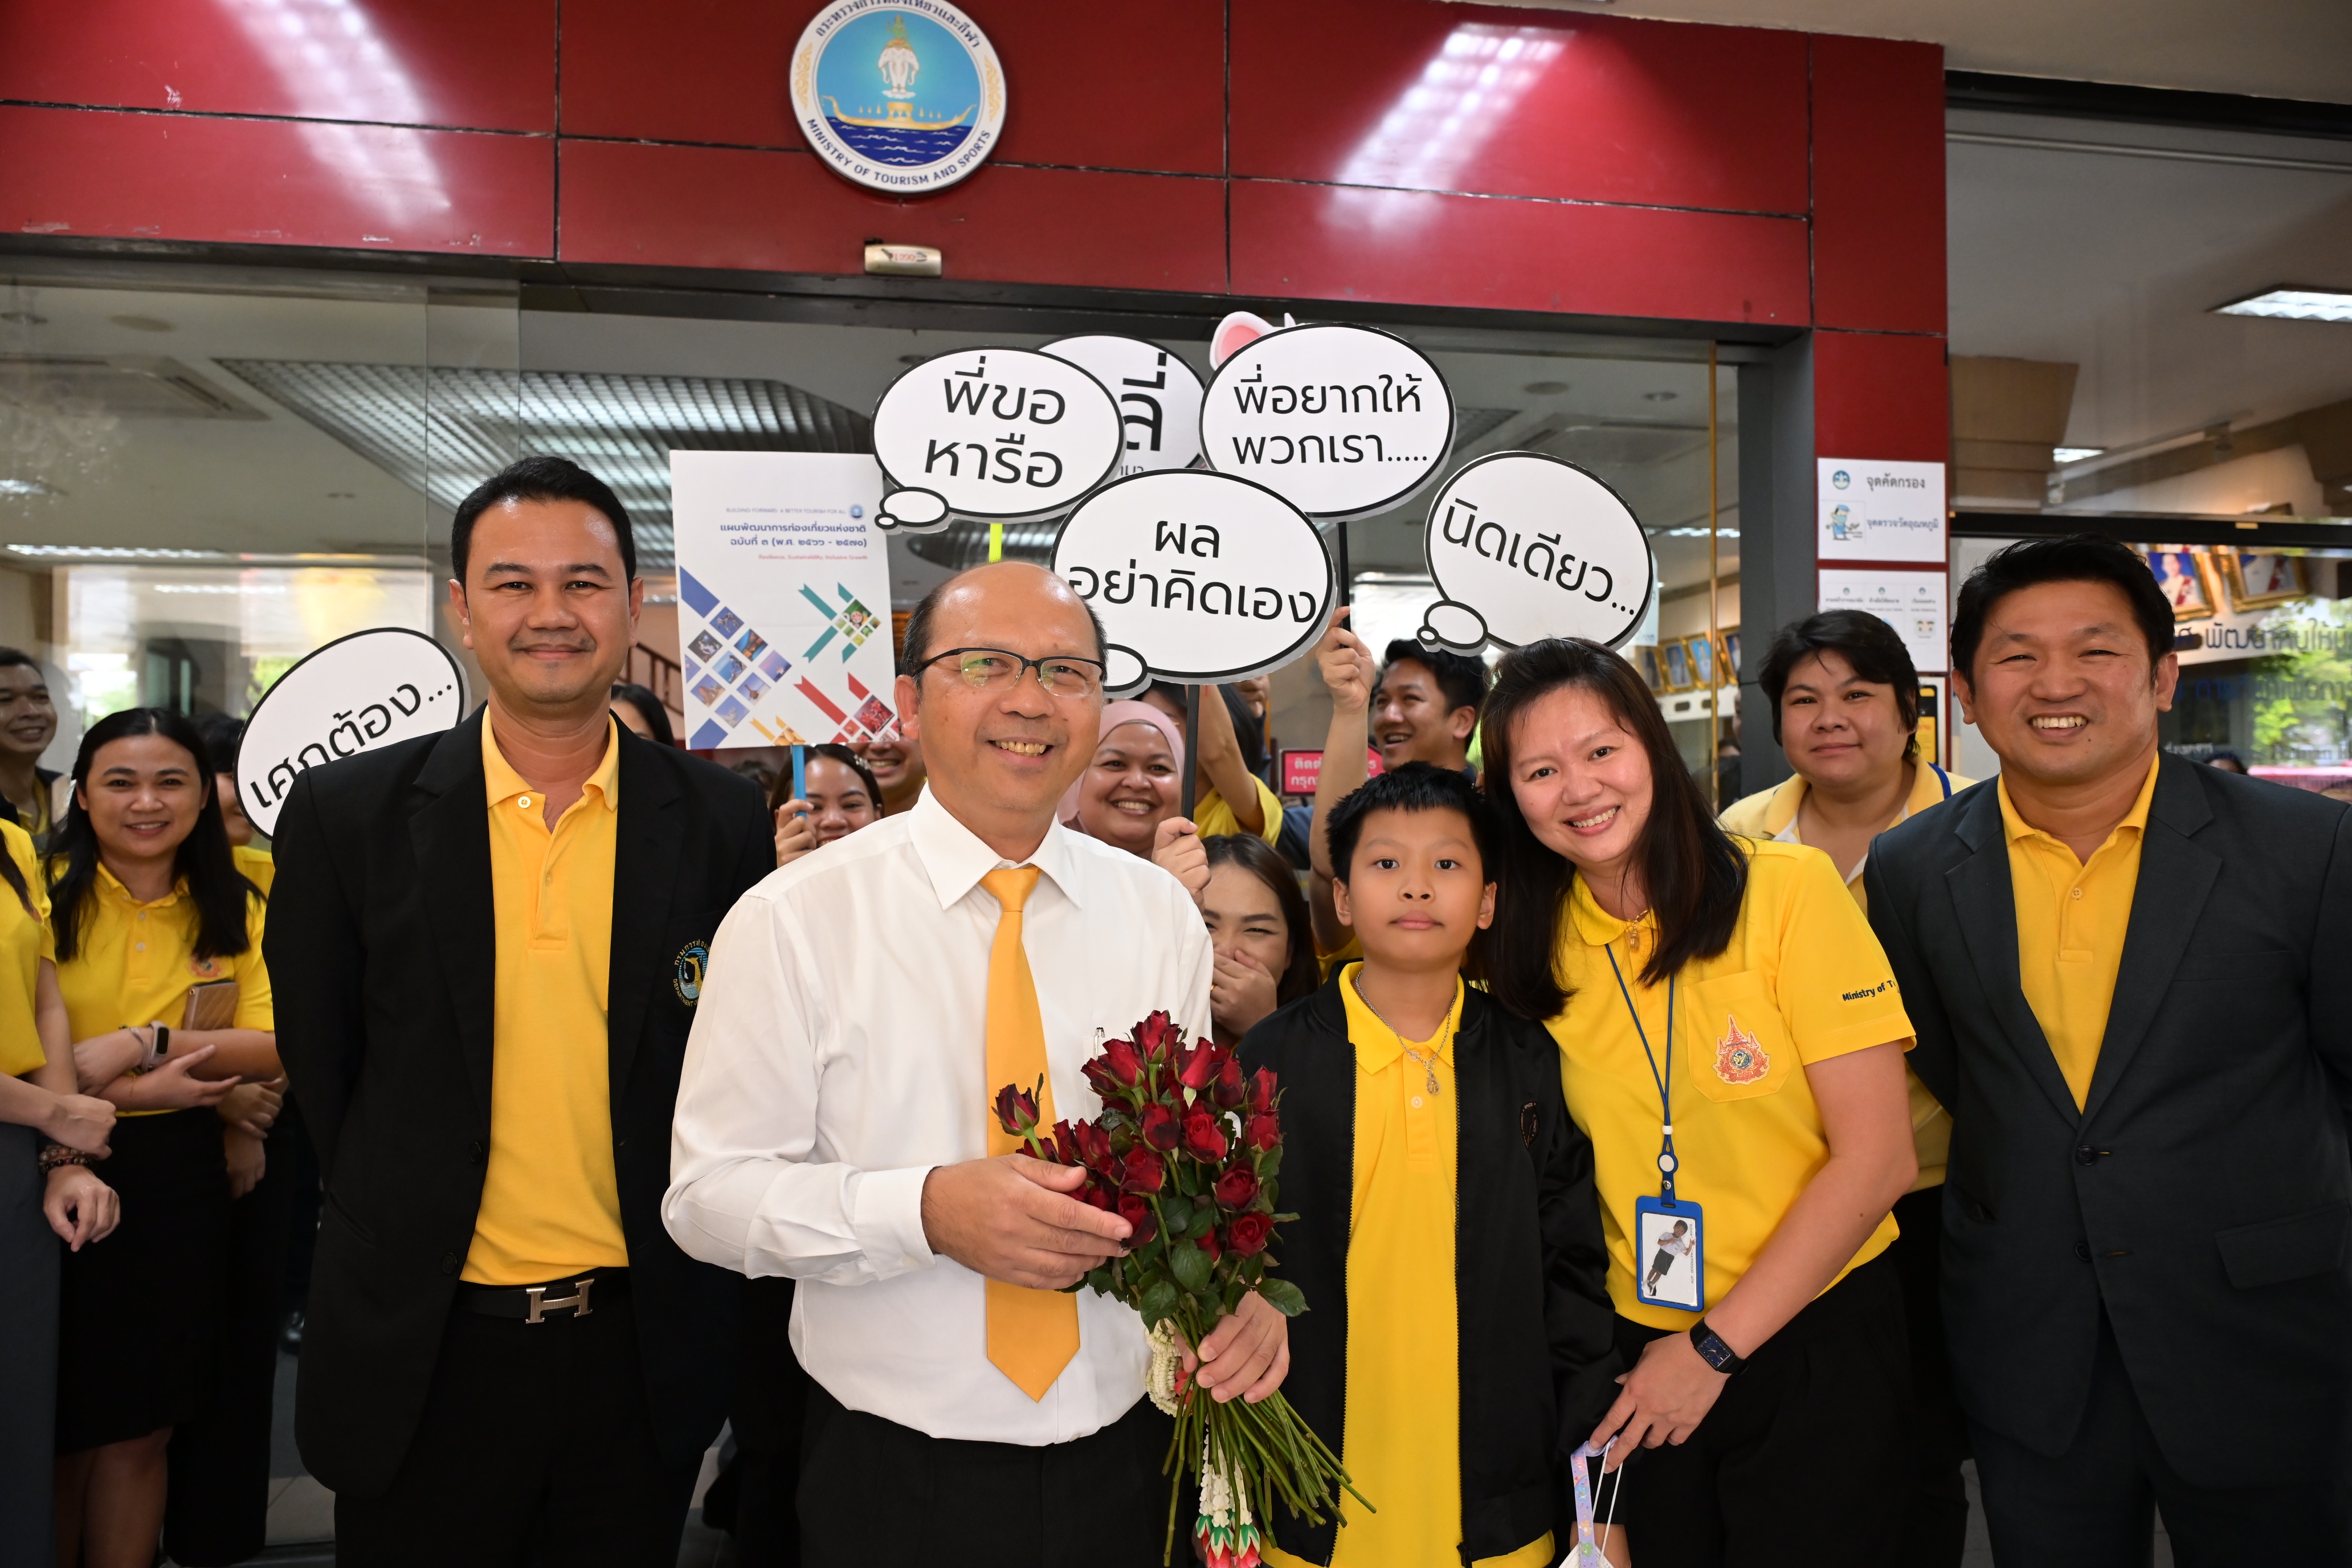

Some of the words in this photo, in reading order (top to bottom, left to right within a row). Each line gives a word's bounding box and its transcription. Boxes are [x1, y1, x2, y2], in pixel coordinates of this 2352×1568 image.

[807, 118, 852, 167] MINISTRY
[854, 164, 869, 177] OF
[874, 172, 929, 185] TOURISM
[933, 165, 958, 181] AND
[958, 130, 991, 168] SPORTS
[943, 356, 1066, 425] พี่ขอ
[1233, 364, 1423, 414] พี่อยากให้
[924, 432, 1063, 488] หารือ
[1867, 472, 1925, 492] จุดคัดกรอง
[720, 521, 867, 533] แผนพัฒนาการท่องเที่ยวแห่งชาติ
[730, 534, 758, 546] ฉบับที่
[1154, 520, 1220, 559] ผล
[1442, 497, 1635, 616] นิดเดียว...
[1068, 558, 1317, 623] อย่าคิดเอง
[673, 978, 694, 1007] DEPARTMENT
[1842, 988, 1876, 1002] Ministry
[1877, 982, 1886, 993] of
